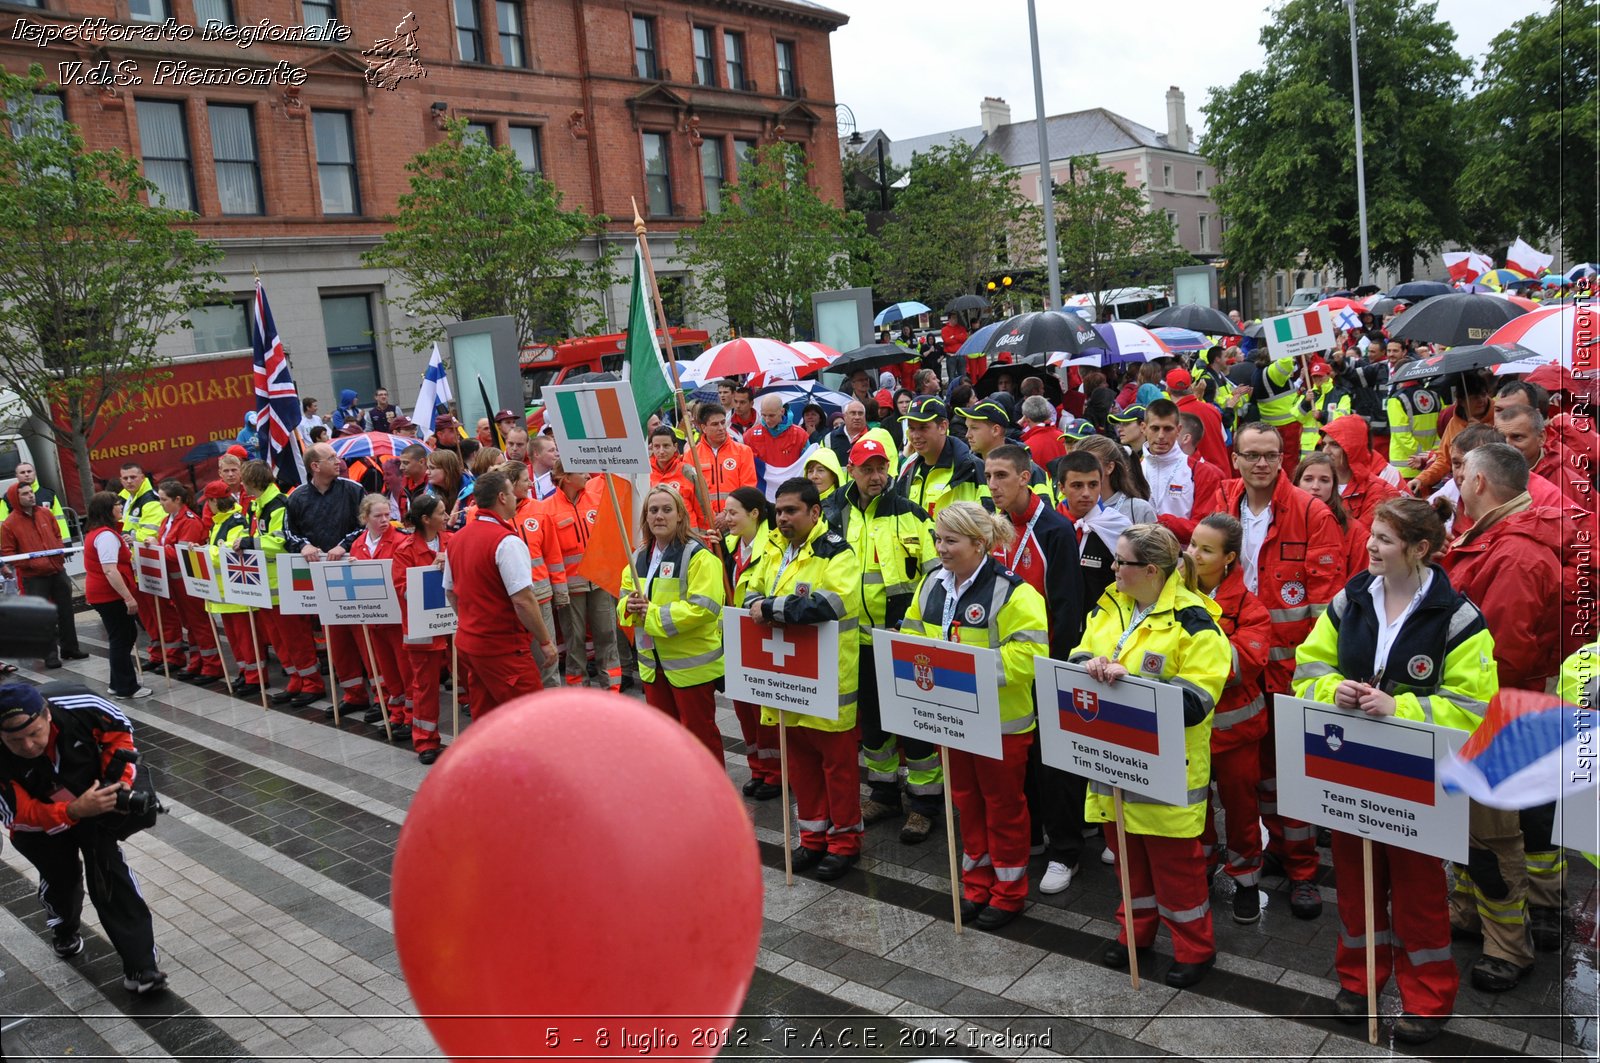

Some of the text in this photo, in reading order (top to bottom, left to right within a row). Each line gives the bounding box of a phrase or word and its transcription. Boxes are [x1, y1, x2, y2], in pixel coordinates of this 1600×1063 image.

[996, 333, 1025, 348] Bass
[1076, 330, 1096, 345] Bass
[1404, 366, 1440, 377] LONDON
[143, 374, 255, 410] MORIART
[90, 439, 166, 462] RANSPORT
[170, 435, 196, 449] LTD
[577, 444, 622, 454] Team Ireland
[569, 457, 598, 465] Foireann
[608, 455, 639, 465] hÉireann
[361, 612, 389, 620] Joukkue
[428, 621, 452, 630] Equipe
[743, 673, 817, 696] Team Switzerland
[750, 687, 810, 707] Team Schweiz
[912, 706, 964, 726] Team Serbia
[913, 719, 942, 734] Србија
[1071, 740, 1149, 771] Team Slovakia
[1094, 761, 1150, 786] Slovensko
[1322, 789, 1416, 821] Team Slovenia
[1320, 803, 1418, 838] Team Slovenija
